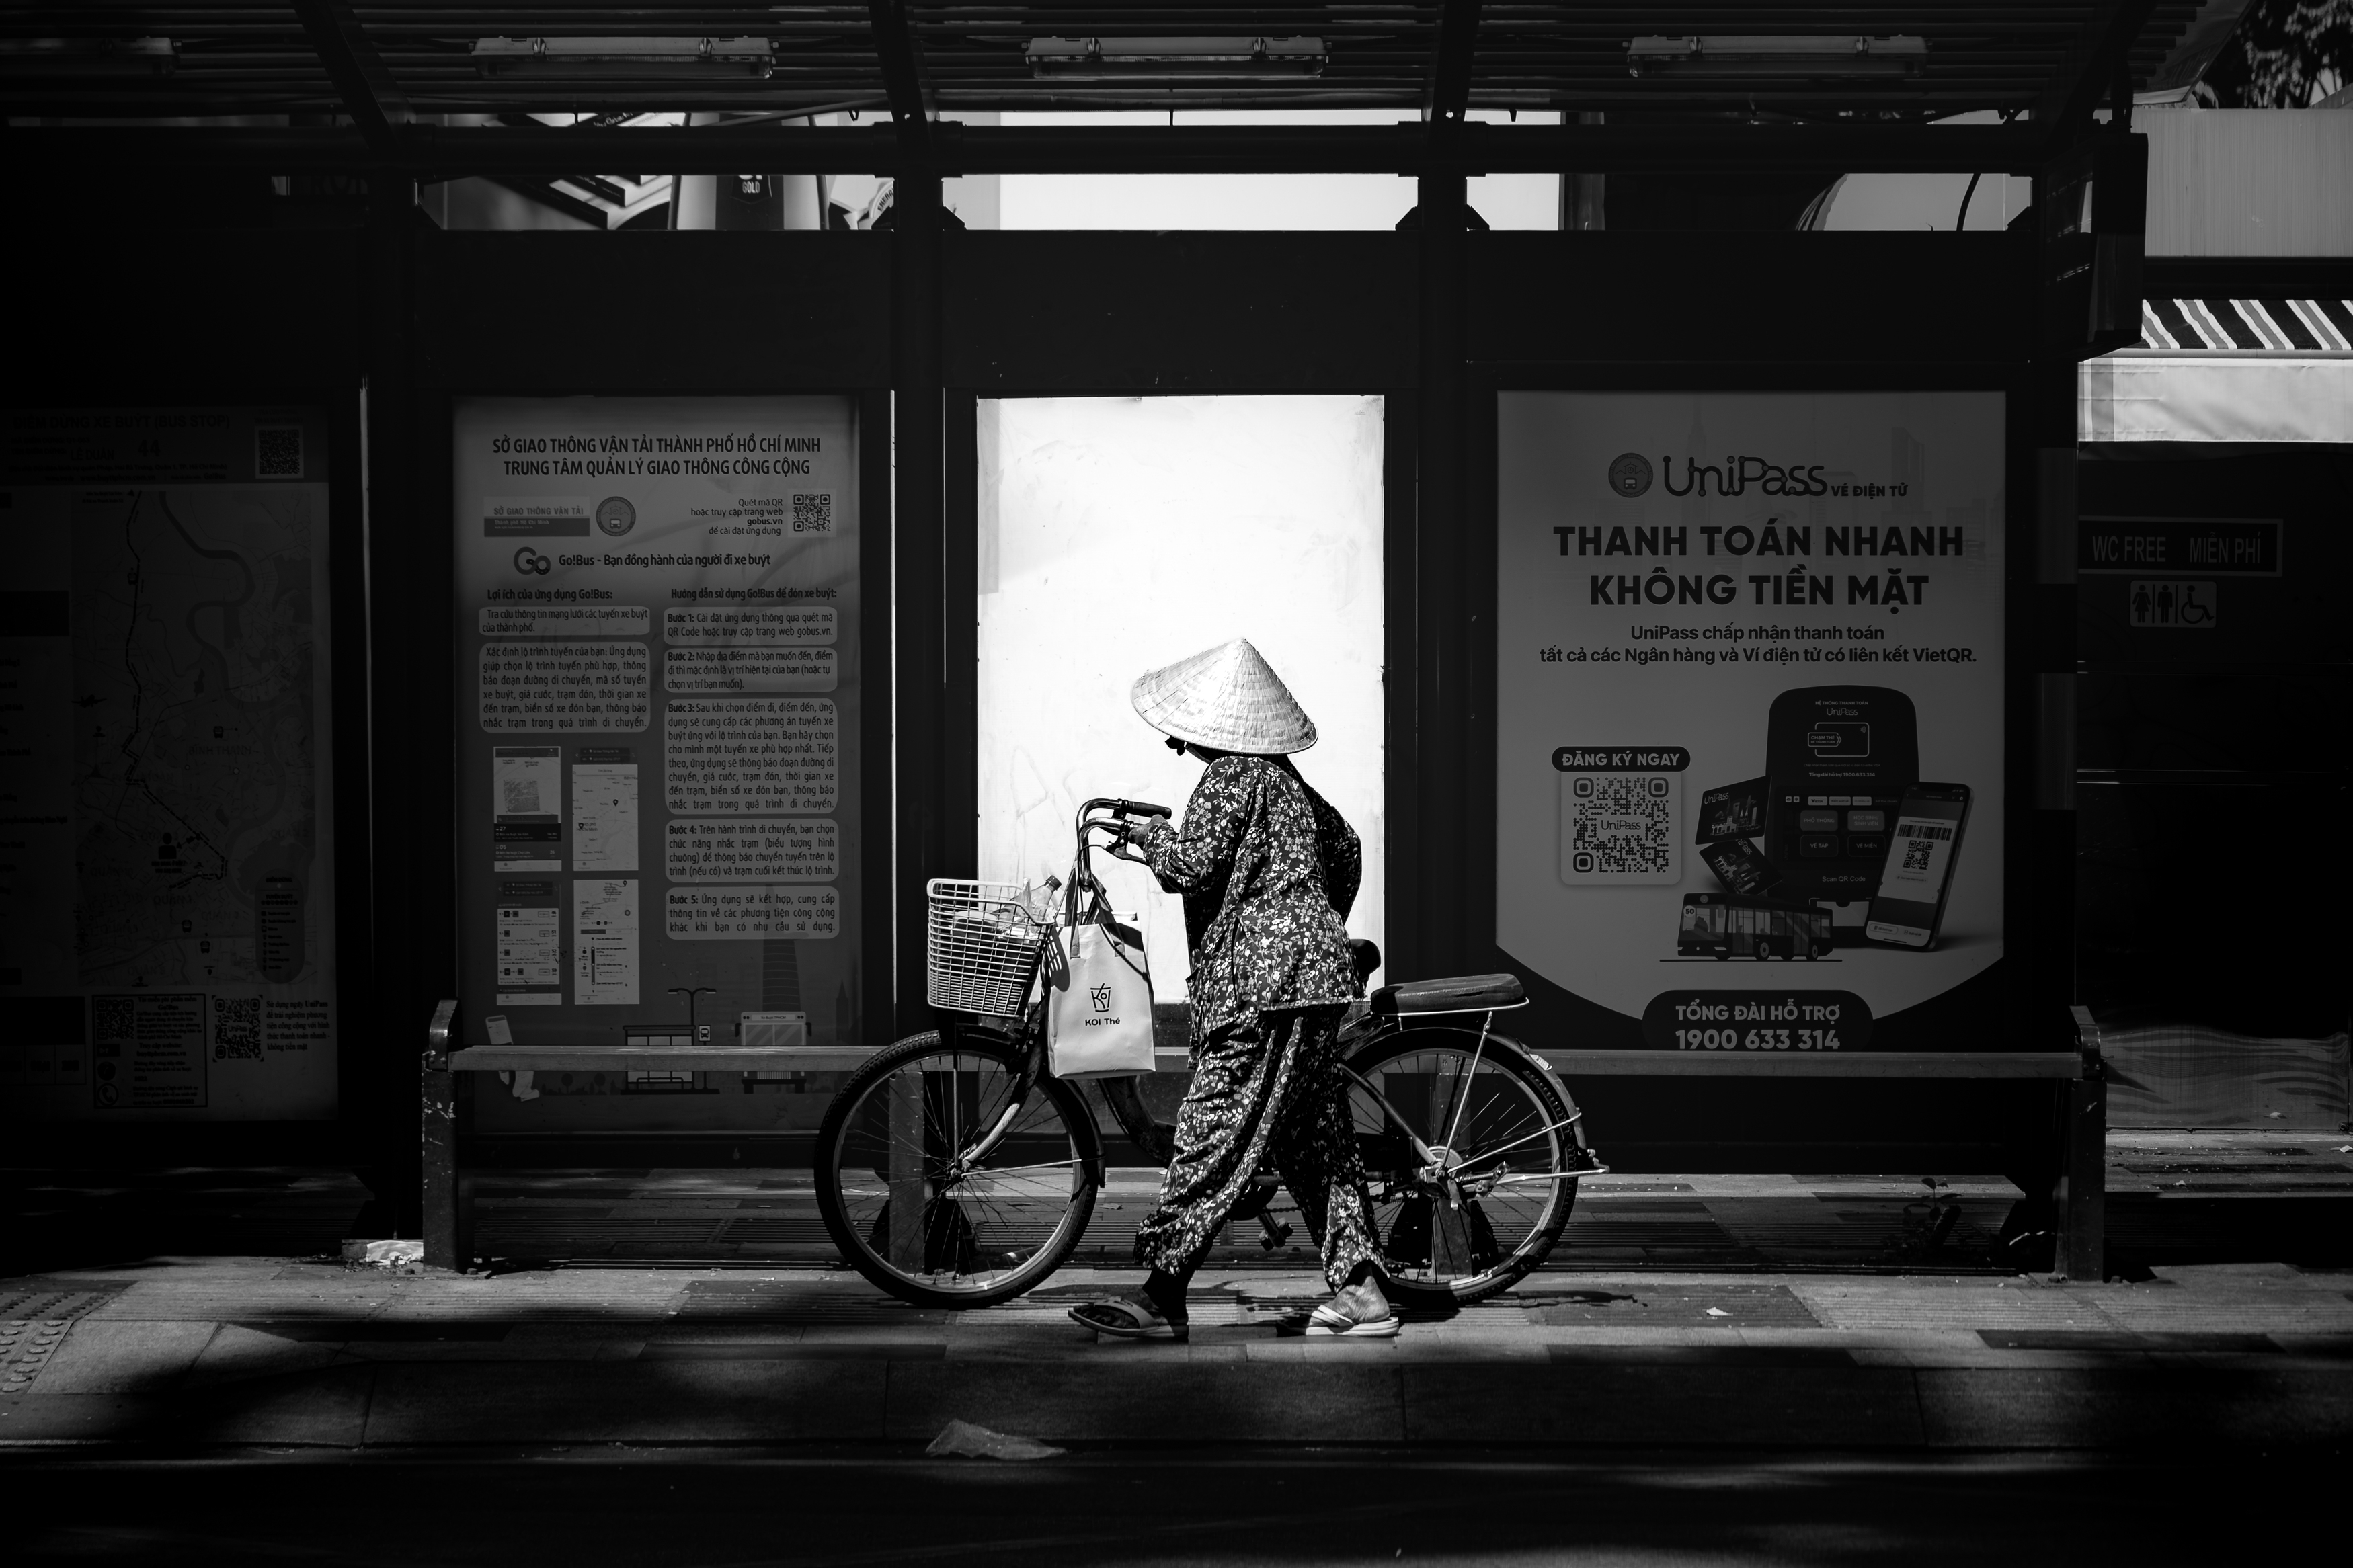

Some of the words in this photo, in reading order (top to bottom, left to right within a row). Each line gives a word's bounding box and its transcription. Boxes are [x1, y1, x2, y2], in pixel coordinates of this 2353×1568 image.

[742, 181, 760, 193] GOLD
[13, 414, 46, 429] ĐIỂM
[50, 413, 90, 429] DỪNG
[93, 415, 112, 429] XE
[114, 413, 151, 428] BUÝT
[154, 415, 187, 431] (BUS
[190, 414, 230, 430] STOP)
[137, 439, 161, 457] 44
[493, 434, 510, 453] SỞ
[514, 438, 547, 453] GIAO
[550, 435, 596, 453] THÔNG
[599, 435, 628, 455] VẬN
[631, 434, 653, 453] TẢI
[656, 434, 703, 453] THÀNH
[706, 432, 734, 452] PHỐ
[737, 432, 756, 452] HỒ
[760, 434, 781, 452] CHÍ
[784, 438, 820, 452] MINH
[504, 460, 549, 475] TRUNG
[552, 457, 583, 475] TÂM
[586, 457, 625, 479] QUẢN
[629, 457, 644, 474] LÝ
[647, 460, 680, 475] GIAO
[683, 457, 729, 474] THÔNG
[733, 457, 770, 474] CÔNG
[773, 457, 809, 477] CỘNG
[1663, 455, 1828, 497] UniPass
[1830, 483, 1849, 497] VÉ
[1852, 483, 1885, 500] ĐIỆN
[1889, 482, 1909, 497] TỬ
[738, 499, 757, 508] Quét
[758, 499, 770, 507] mã
[772, 498, 783, 507] QR
[691, 508, 709, 517] hoặc
[711, 509, 727, 518] truy
[728, 508, 742, 518] cập
[744, 508, 764, 518] trang
[766, 507, 783, 515] web
[747, 516, 783, 527] gobus.vn
[709, 526, 718, 535] để
[731, 526, 745, 535] đặt
[746, 527, 760, 536] ứng
[762, 526, 781, 536] dụng
[1553, 526, 1687, 556] THANH
[1700, 518, 1811, 556] TOÁN
[1825, 526, 1963, 556] NHANH
[2092, 536, 2118, 561] WC
[2124, 536, 2166, 562] FREE
[2190, 531, 2229, 563] MIỄN
[2235, 531, 2261, 563] PHÍ
[559, 554, 595, 566] Go!Bus
[604, 554, 623, 567] Bạn
[624, 553, 649, 568] đồng
[651, 554, 675, 565] hành
[676, 553, 694, 565] của
[695, 554, 722, 568] người
[723, 553, 733, 565] đi
[734, 556, 747, 565] xe
[748, 553, 771, 567] buýt
[487, 589, 500, 602] Lợi
[502, 589, 515, 600] ích
[517, 589, 533, 600] của
[534, 589, 552, 602] ứng
[553, 589, 577, 602] dụng
[578, 589, 613, 600] Go!Bus:
[671, 589, 696, 602] Hướng
[698, 587, 713, 598] dẫn
[715, 587, 725, 598] sử
[725, 587, 746, 602] dụng
[747, 588, 774, 598] Go!Bus
[776, 586, 787, 598] để
[788, 587, 803, 598] đón
[804, 590, 815, 598] xe
[816, 587, 836, 600] buýt:
[1591, 566, 1737, 605] KHÔNG
[1748, 563, 1833, 605] TIỀN
[1847, 567, 1929, 614] MẶT
[487, 609, 499, 619] Tra
[500, 609, 514, 619] cứu
[514, 609, 536, 621] thông
[537, 609, 547, 618] tin
[548, 611, 569, 621] mạng
[570, 608, 584, 618] lưới
[585, 609, 598, 618] các
[598, 608, 620, 620] tuyến
[621, 610, 630, 618] xe
[631, 608, 648, 620] buýt
[1631, 625, 1699, 640] UniPass
[1702, 622, 1745, 643] chấp
[1748, 624, 1790, 640] nhận
[1794, 625, 1843, 640] thanh
[1846, 625, 1884, 640] toán
[1540, 644, 1563, 663] tất
[1566, 647, 1587, 662] cả
[1591, 647, 1621, 662] các
[1625, 647, 1669, 665] Ngân
[1673, 647, 1715, 665] hàng
[1718, 647, 1739, 662] và
[1743, 647, 1760, 662] Ví
[1763, 647, 1799, 666] điện
[1803, 647, 1822, 662] tử
[1825, 647, 1845, 662] có
[1849, 647, 1878, 662] liên
[1883, 644, 1909, 662] kết
[1913, 647, 1977, 663] VietQR.
[1562, 750, 1607, 766] ĐĂNG
[1612, 750, 1632, 766] KÝ
[1637, 753, 1680, 766] NGAY
[1704, 792, 1729, 804] UniPass
[1601, 820, 1641, 831] UniPass
[1675, 999, 1729, 1020] TỔNG
[1734, 1001, 1765, 1020] ĐÀI
[1771, 999, 1798, 1020] HỖ
[1802, 1004, 1840, 1024] TRỢ
[1085, 1018, 1101, 1026] KOI
[1104, 1017, 1121, 1026] Thé
[1675, 1029, 1737, 1049] 1900
[1745, 1030, 1790, 1049] 633
[1798, 1030, 1840, 1049] 314
